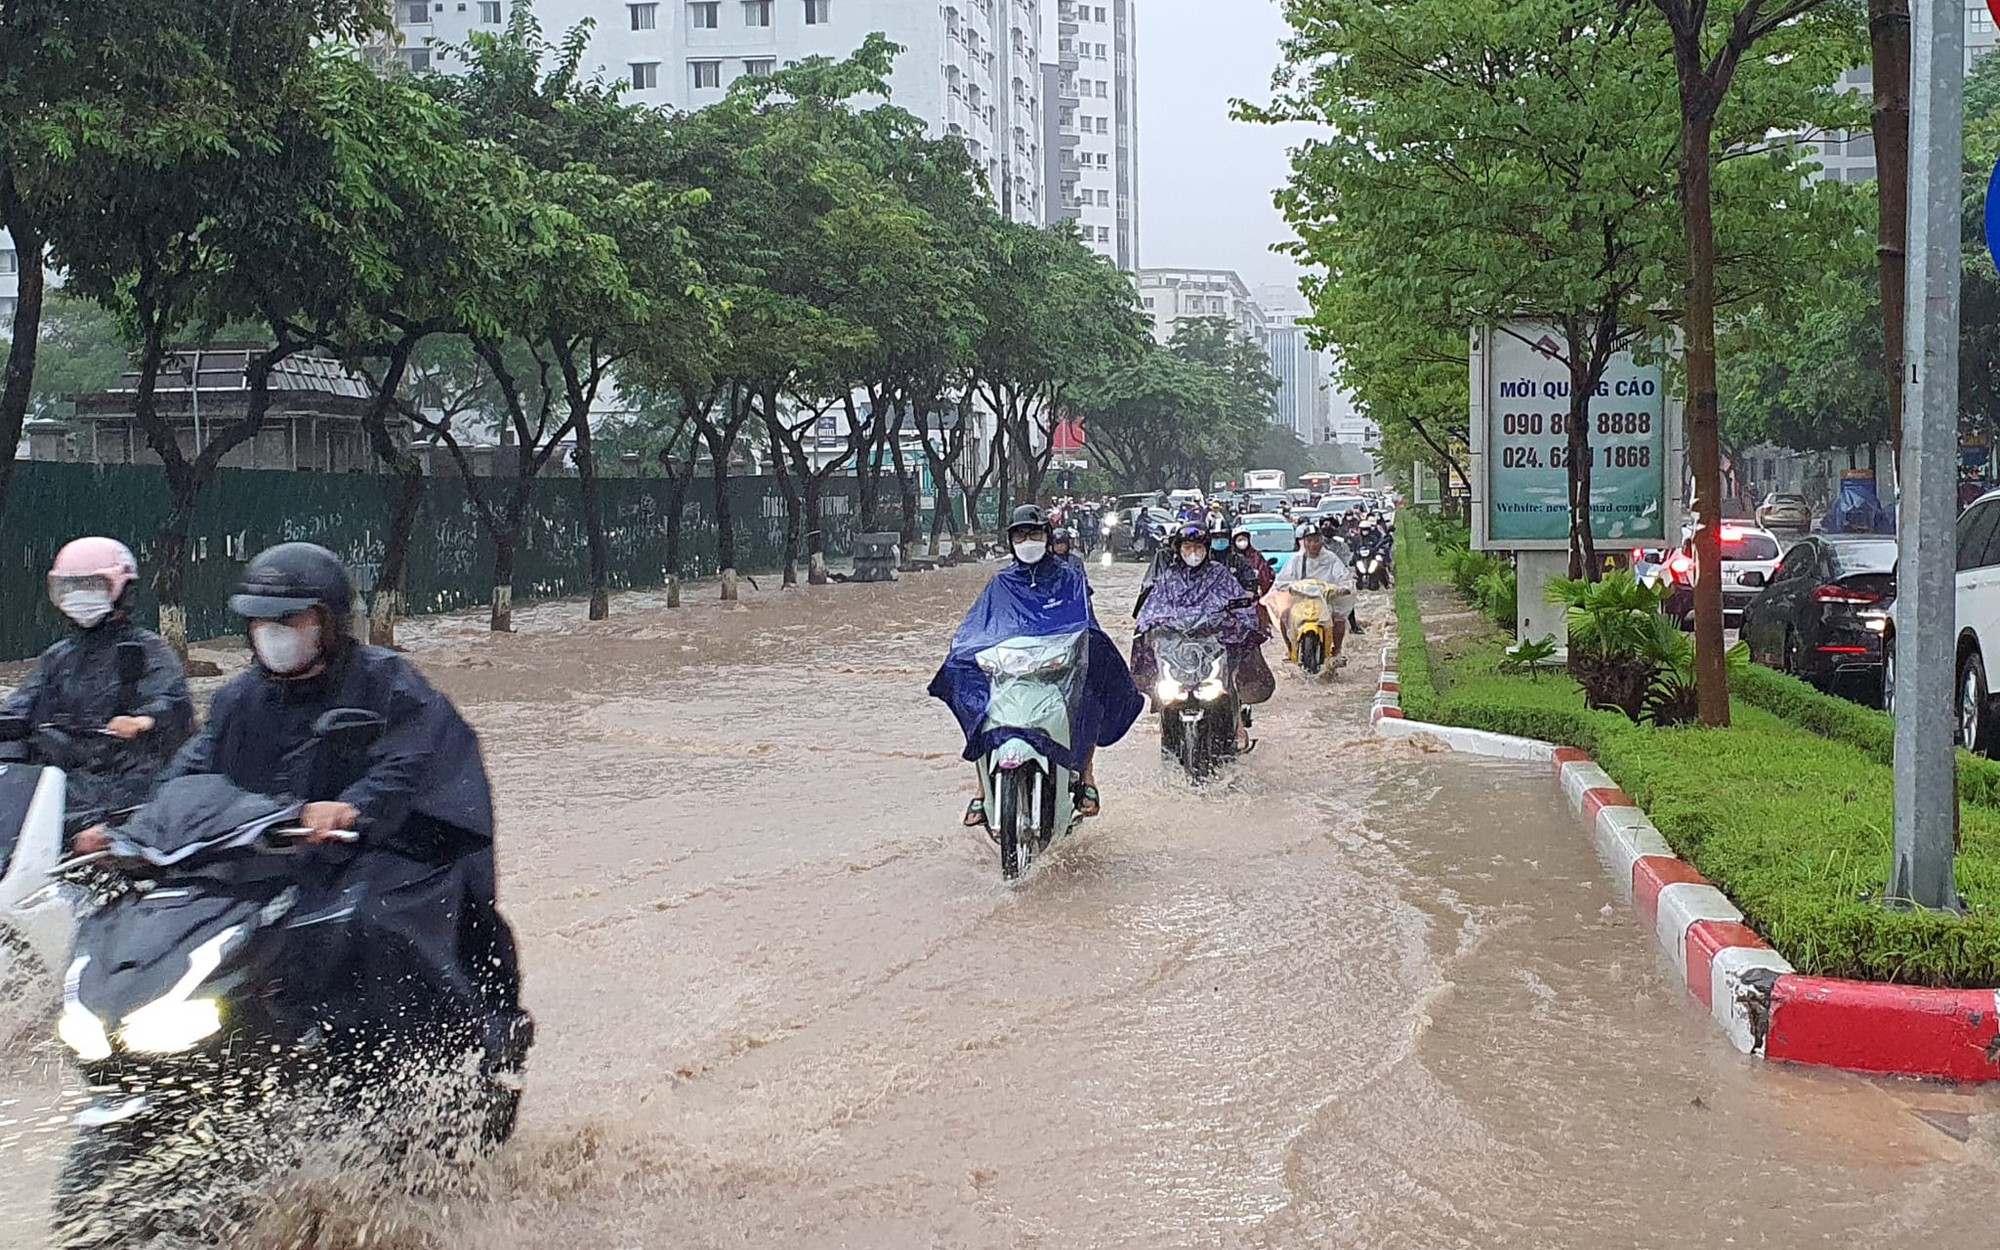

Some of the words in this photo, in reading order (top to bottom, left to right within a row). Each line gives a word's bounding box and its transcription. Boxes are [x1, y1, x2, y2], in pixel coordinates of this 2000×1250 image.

[1500, 377, 1536, 398] MỜI
[1543, 381, 1609, 400] QUG
[1615, 376, 1655, 396] CÁO
[1503, 413, 1543, 435] 090
[1597, 412, 1651, 434] 8888
[1503, 447, 1543, 468] 024.
[1551, 447, 1594, 468] 621
[1603, 446, 1650, 468] 1868
[1497, 503, 1543, 513] Website:
